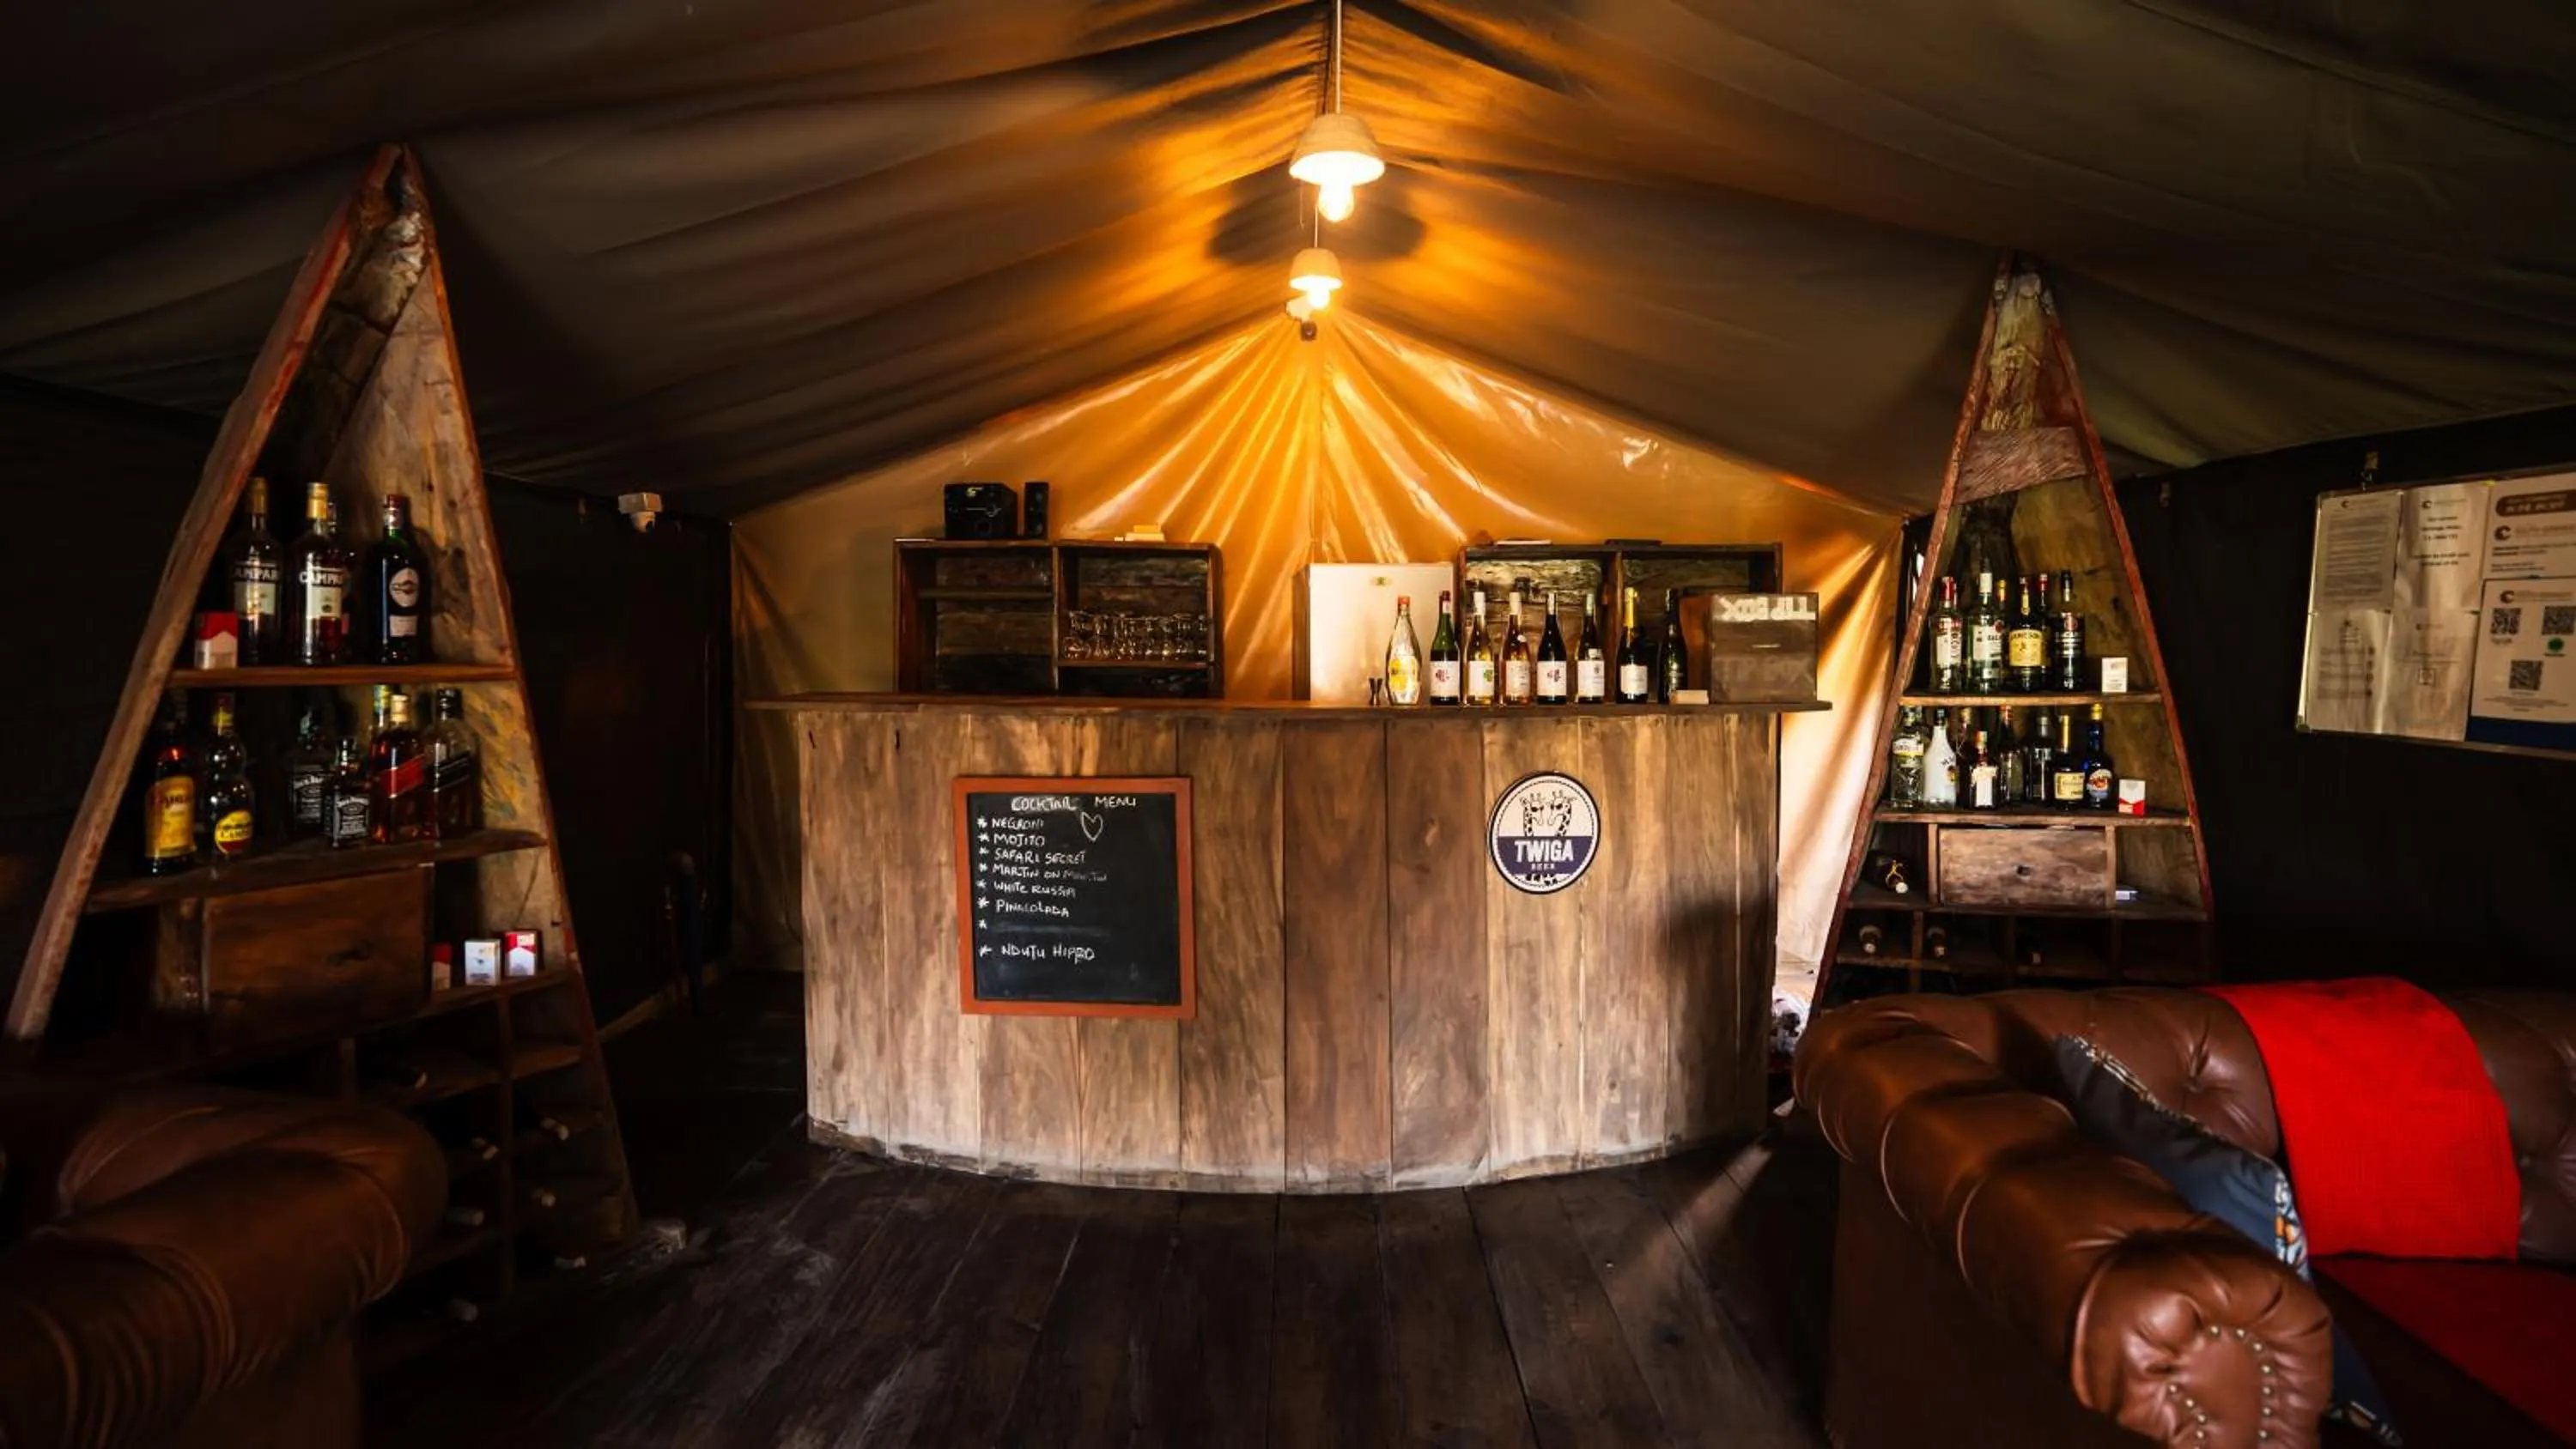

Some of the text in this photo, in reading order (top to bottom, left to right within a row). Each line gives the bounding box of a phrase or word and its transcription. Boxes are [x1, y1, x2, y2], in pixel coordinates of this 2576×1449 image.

[1095, 796, 1136, 809] MENU
[992, 817, 1044, 830] NEGRONI
[993, 834, 1045, 847] MOJITO
[994, 848, 1040, 864] SAFARI
[1514, 840, 1574, 863] TWIGA
[993, 882, 1028, 894] WHITE
